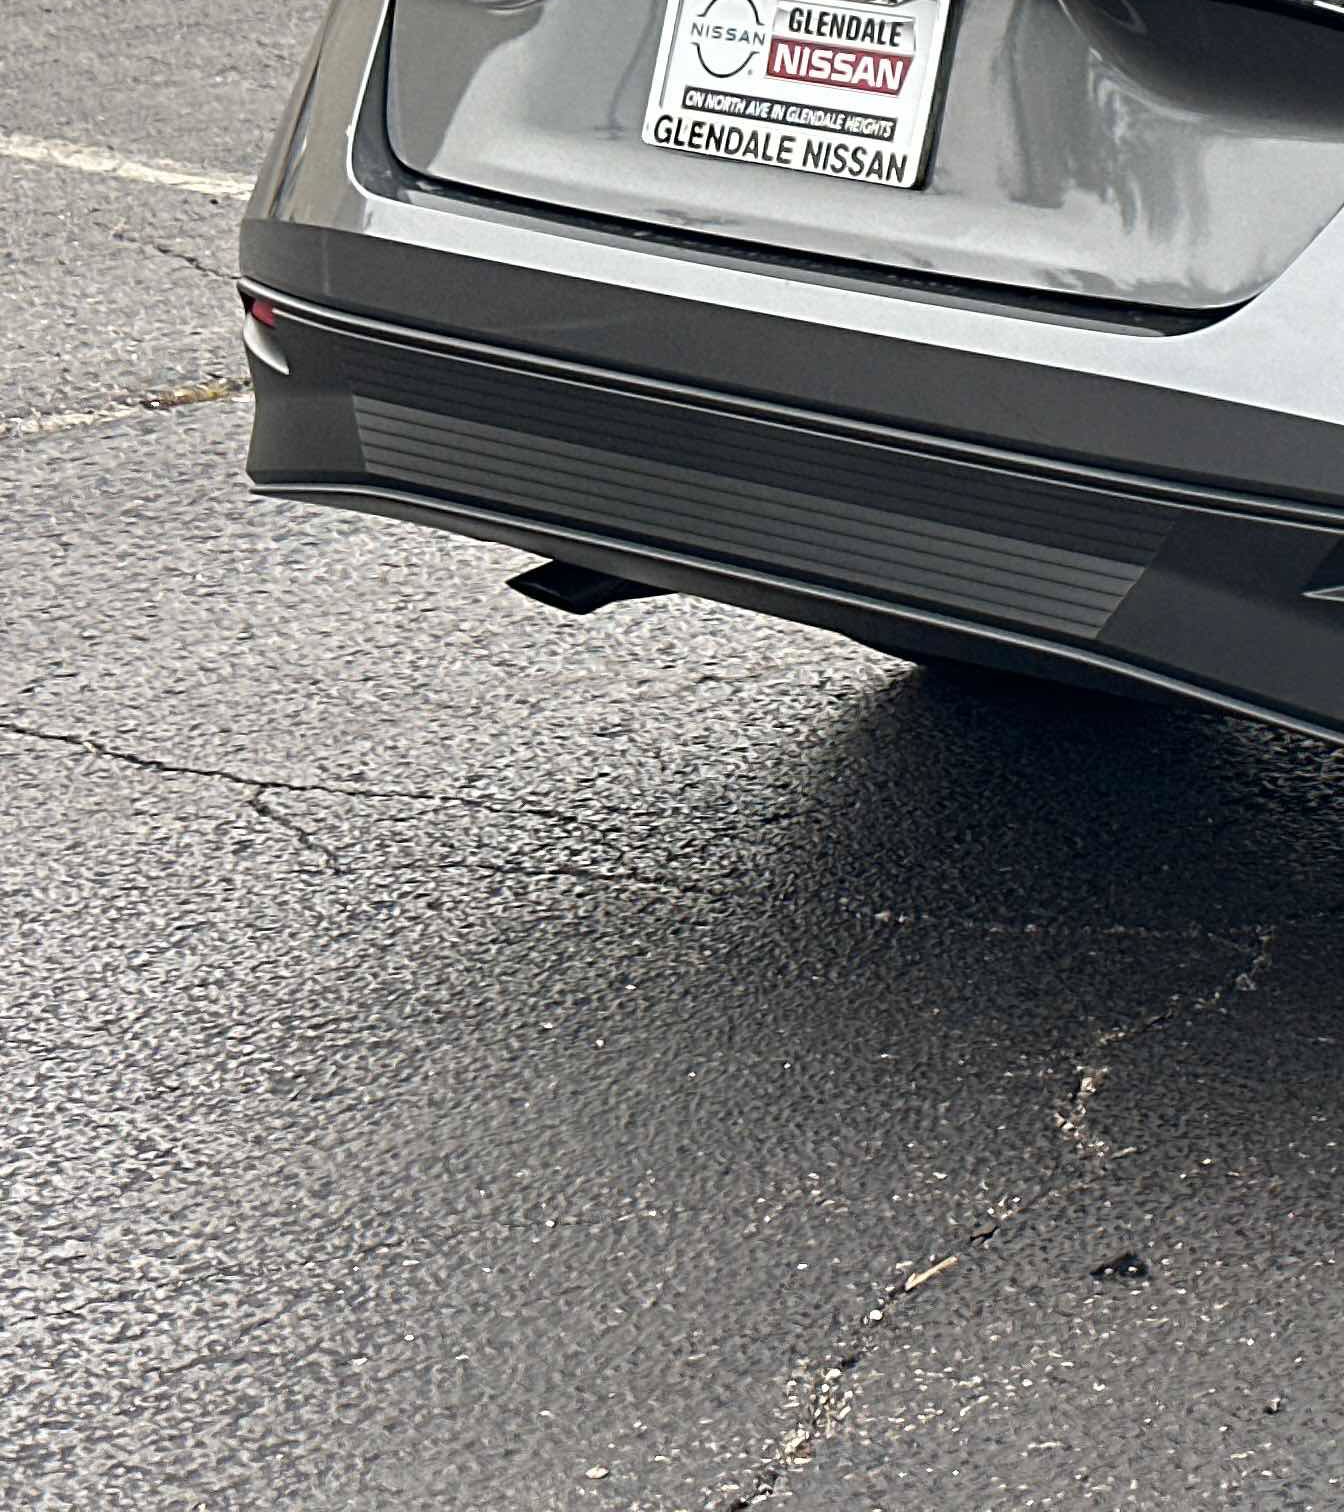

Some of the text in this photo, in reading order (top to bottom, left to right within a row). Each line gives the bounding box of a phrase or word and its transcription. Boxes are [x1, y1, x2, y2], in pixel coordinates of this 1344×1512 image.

[690, 21, 766, 47] NISSAN
[788, 7, 904, 47] GLENDALE
[772, 43, 904, 88] NISSAN
[685, 90, 894, 138] ON NORTH AVE IN GLENDALE HEIGHTS
[653, 114, 908, 183] GLENDALE NISSAN
